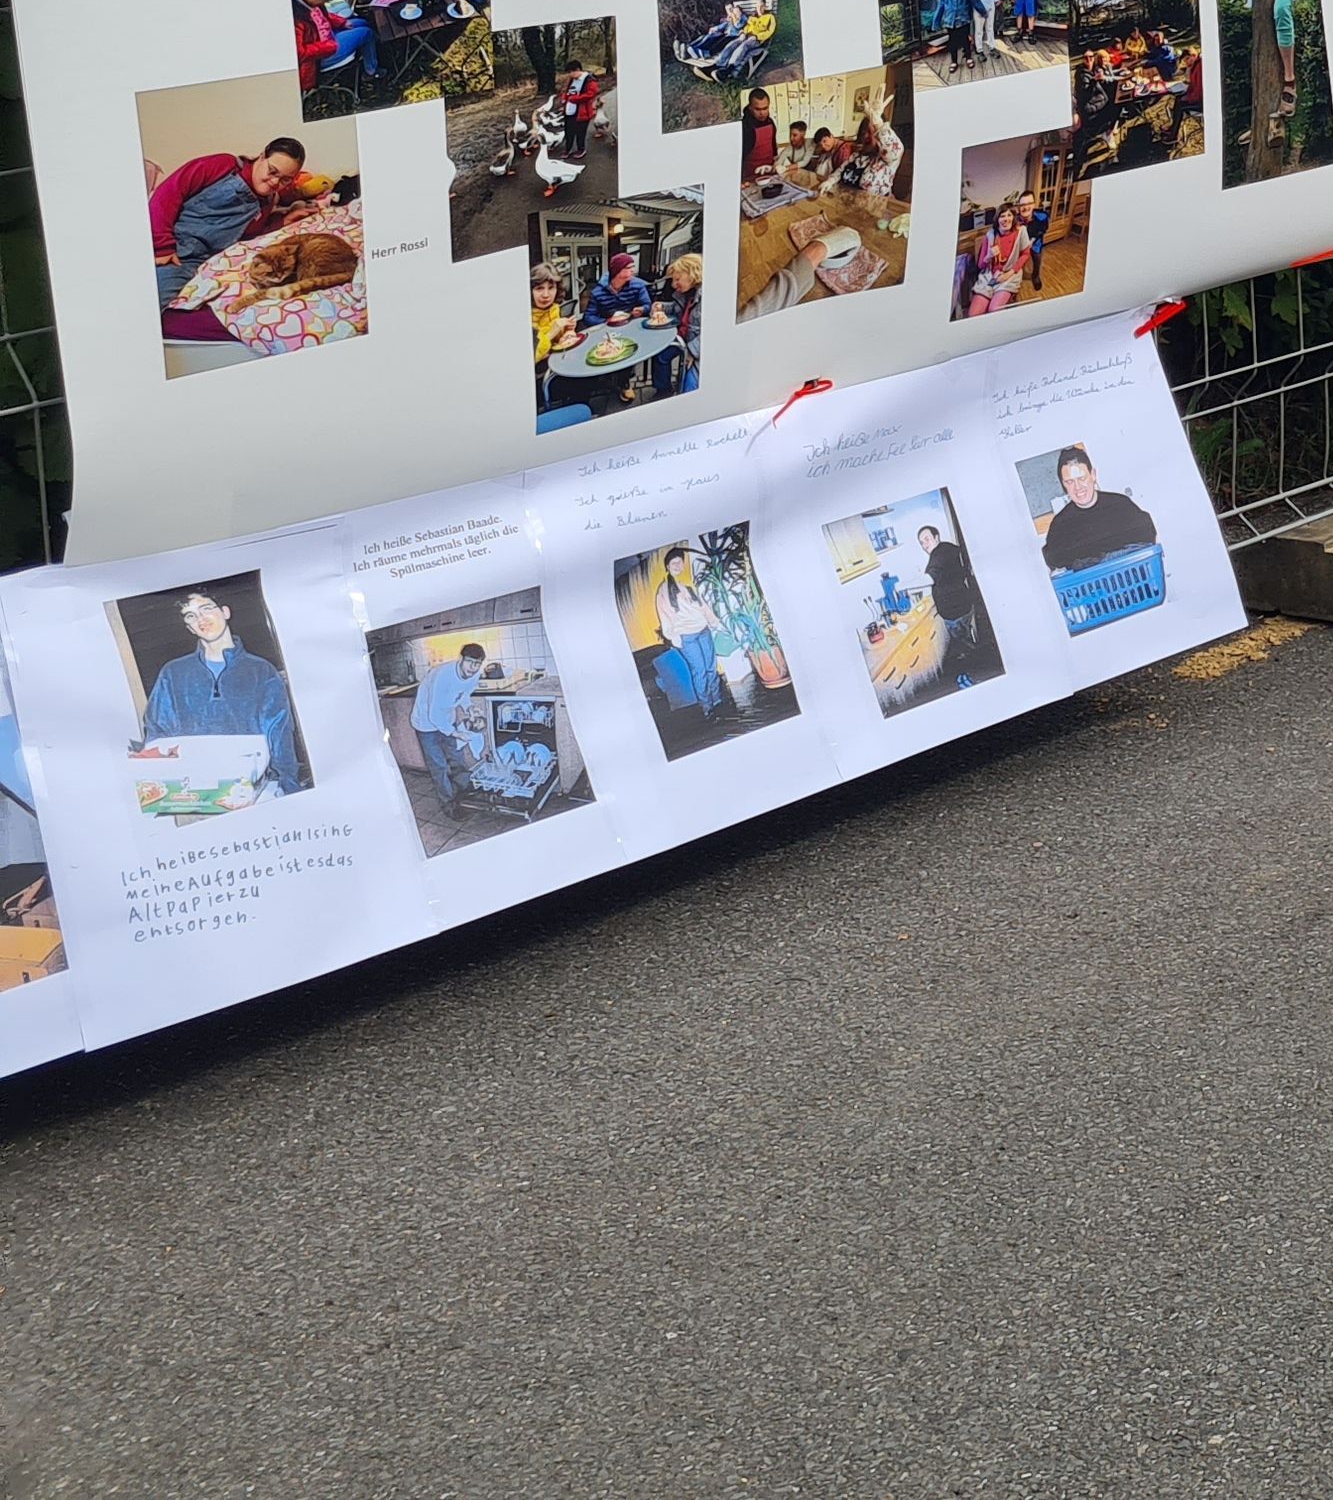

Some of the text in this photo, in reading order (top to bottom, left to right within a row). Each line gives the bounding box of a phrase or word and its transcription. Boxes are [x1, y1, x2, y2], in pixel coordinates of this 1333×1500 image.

[371, 237, 428, 259] Herr Rossi
[352, 524, 519, 573] Ich räume mehrmals täglich die
[363, 514, 503, 555] Ich heiße Sebastian Baade.
[389, 547, 492, 579] Spülmaschine leer.
[121, 866, 152, 887] Ich
